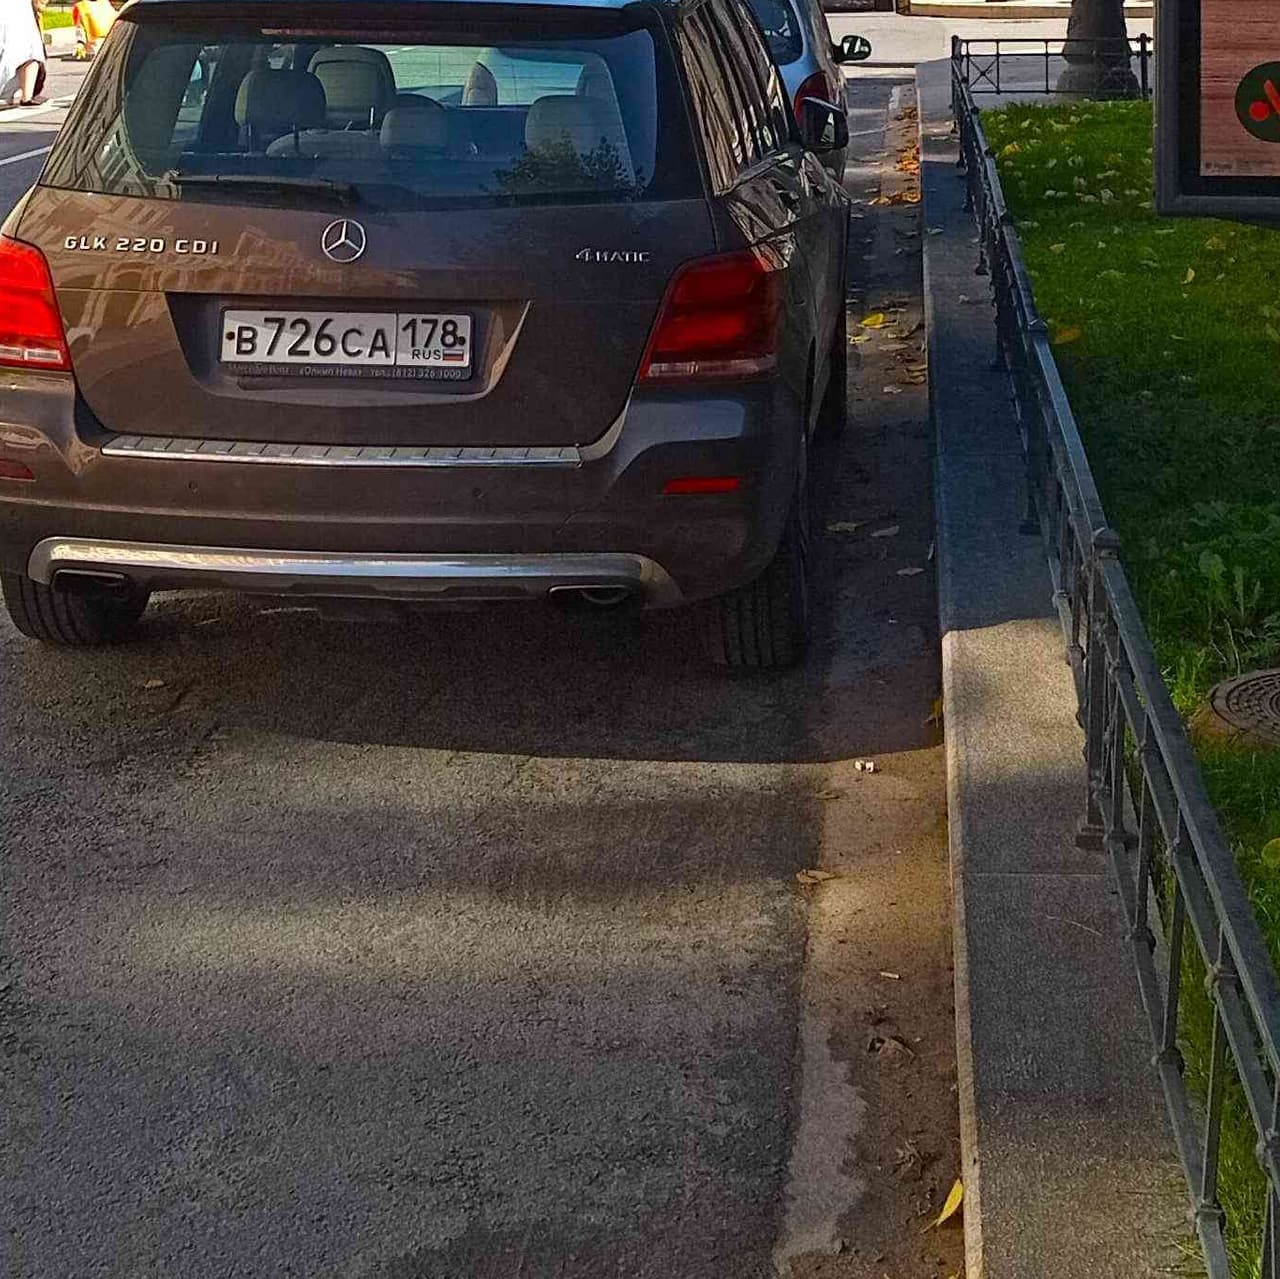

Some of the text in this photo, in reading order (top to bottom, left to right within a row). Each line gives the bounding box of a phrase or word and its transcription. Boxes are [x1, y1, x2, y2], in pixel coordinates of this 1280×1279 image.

[64, 236, 219, 254] GLK 220 CDI
[575, 247, 650, 262] 4MATIC
[402, 318, 459, 349] 178
[411, 348, 442, 361] RUS
